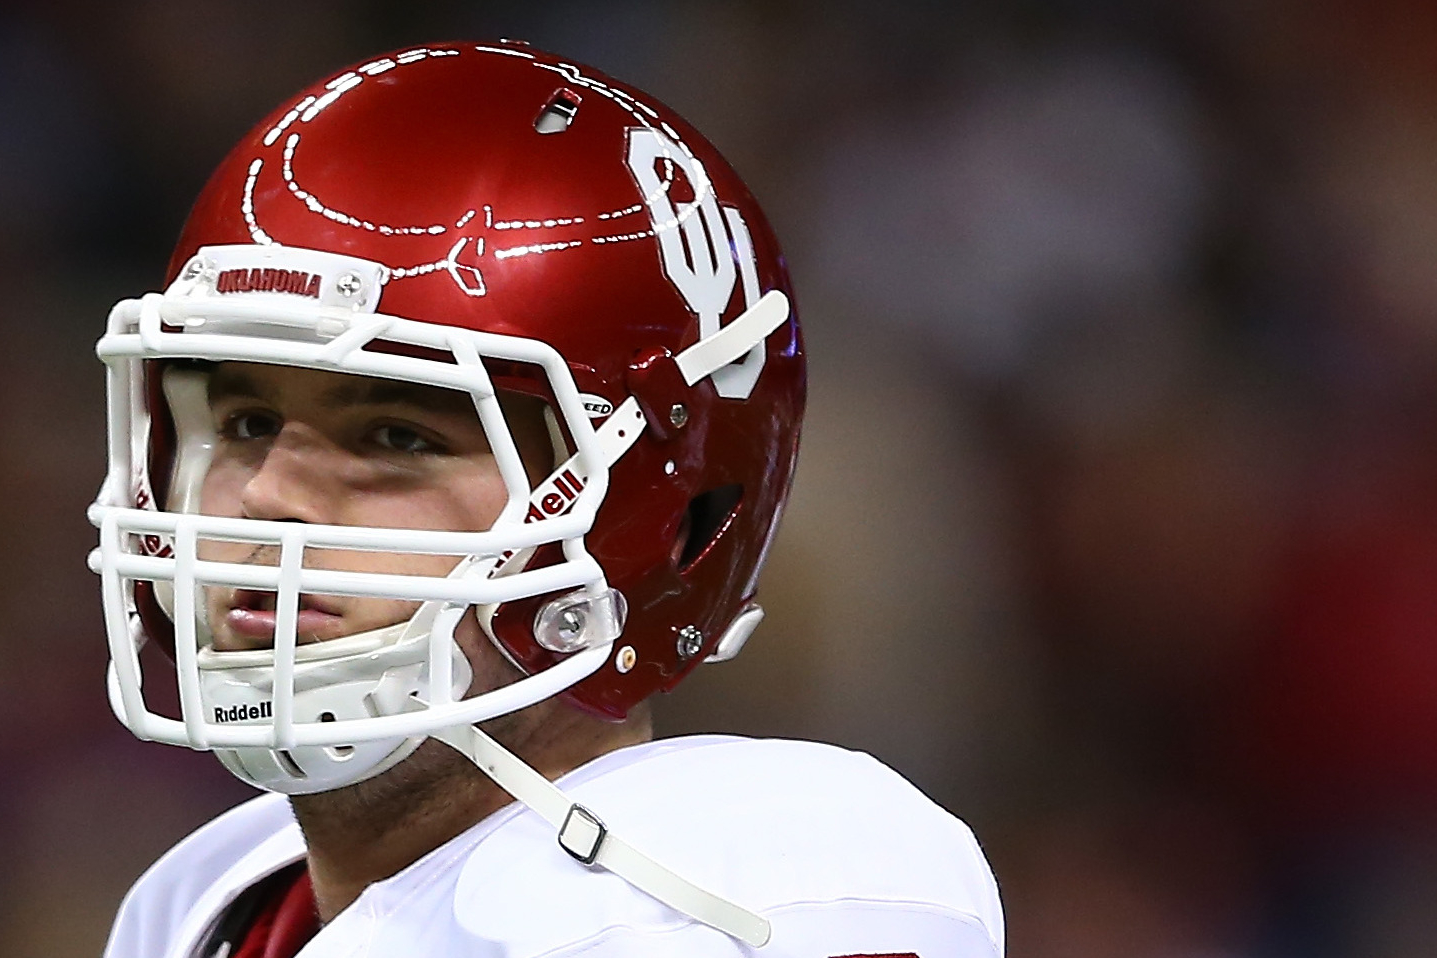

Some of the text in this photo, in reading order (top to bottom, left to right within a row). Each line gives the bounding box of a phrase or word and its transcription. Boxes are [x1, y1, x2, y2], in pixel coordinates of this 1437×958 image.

[624, 127, 766, 399] OU
[216, 267, 322, 299] OKLAHOMA
[583, 402, 611, 415] EED
[214, 700, 272, 723] Riddell
